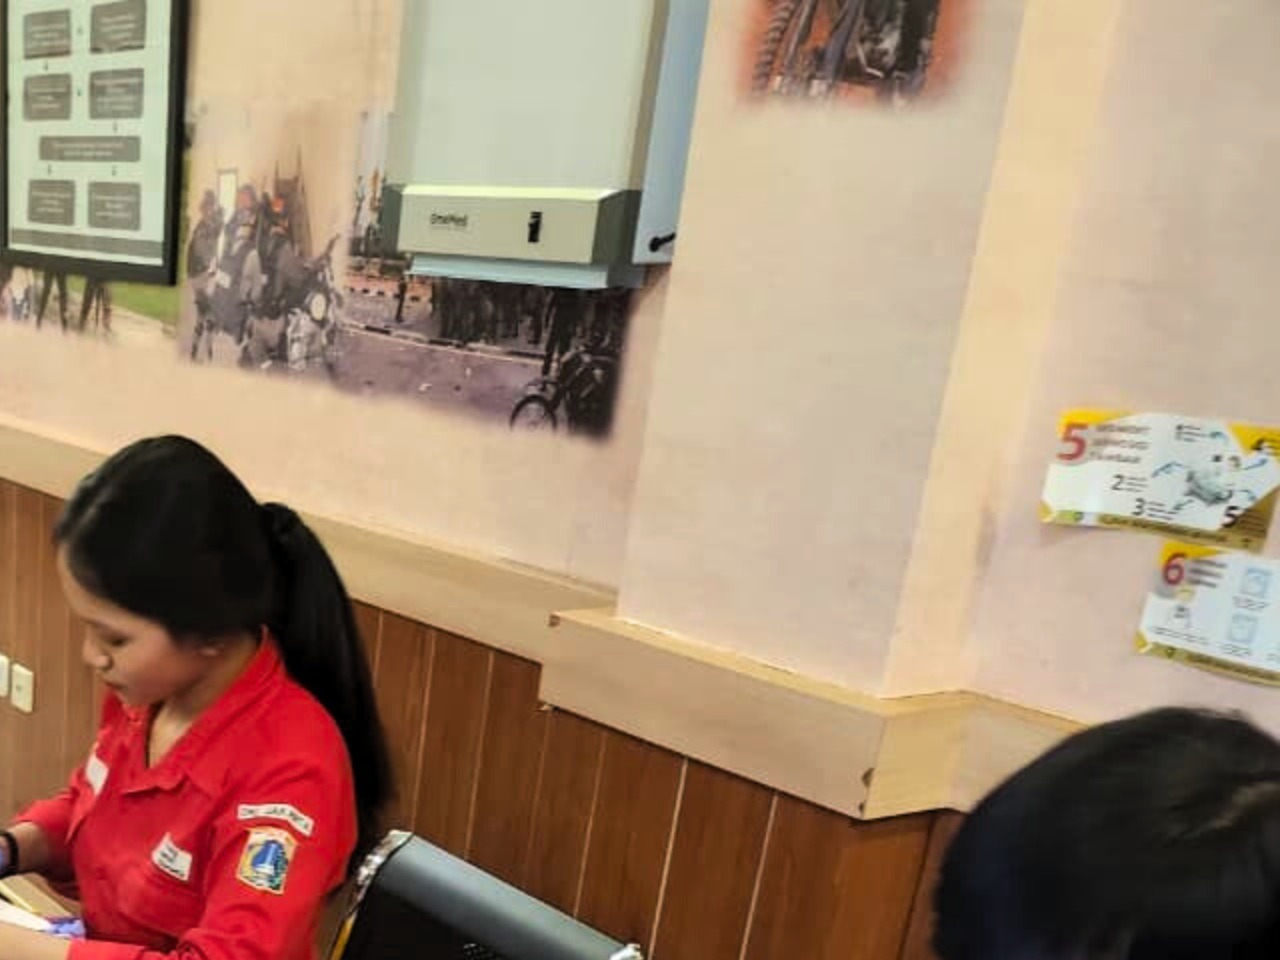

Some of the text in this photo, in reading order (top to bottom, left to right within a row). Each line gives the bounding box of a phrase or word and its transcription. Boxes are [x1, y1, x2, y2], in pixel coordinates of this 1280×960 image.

[1057, 423, 1089, 460] 5
[1111, 474, 1125, 491] 2
[1133, 498, 1145, 516] 3
[1163, 552, 1186, 585] 6
